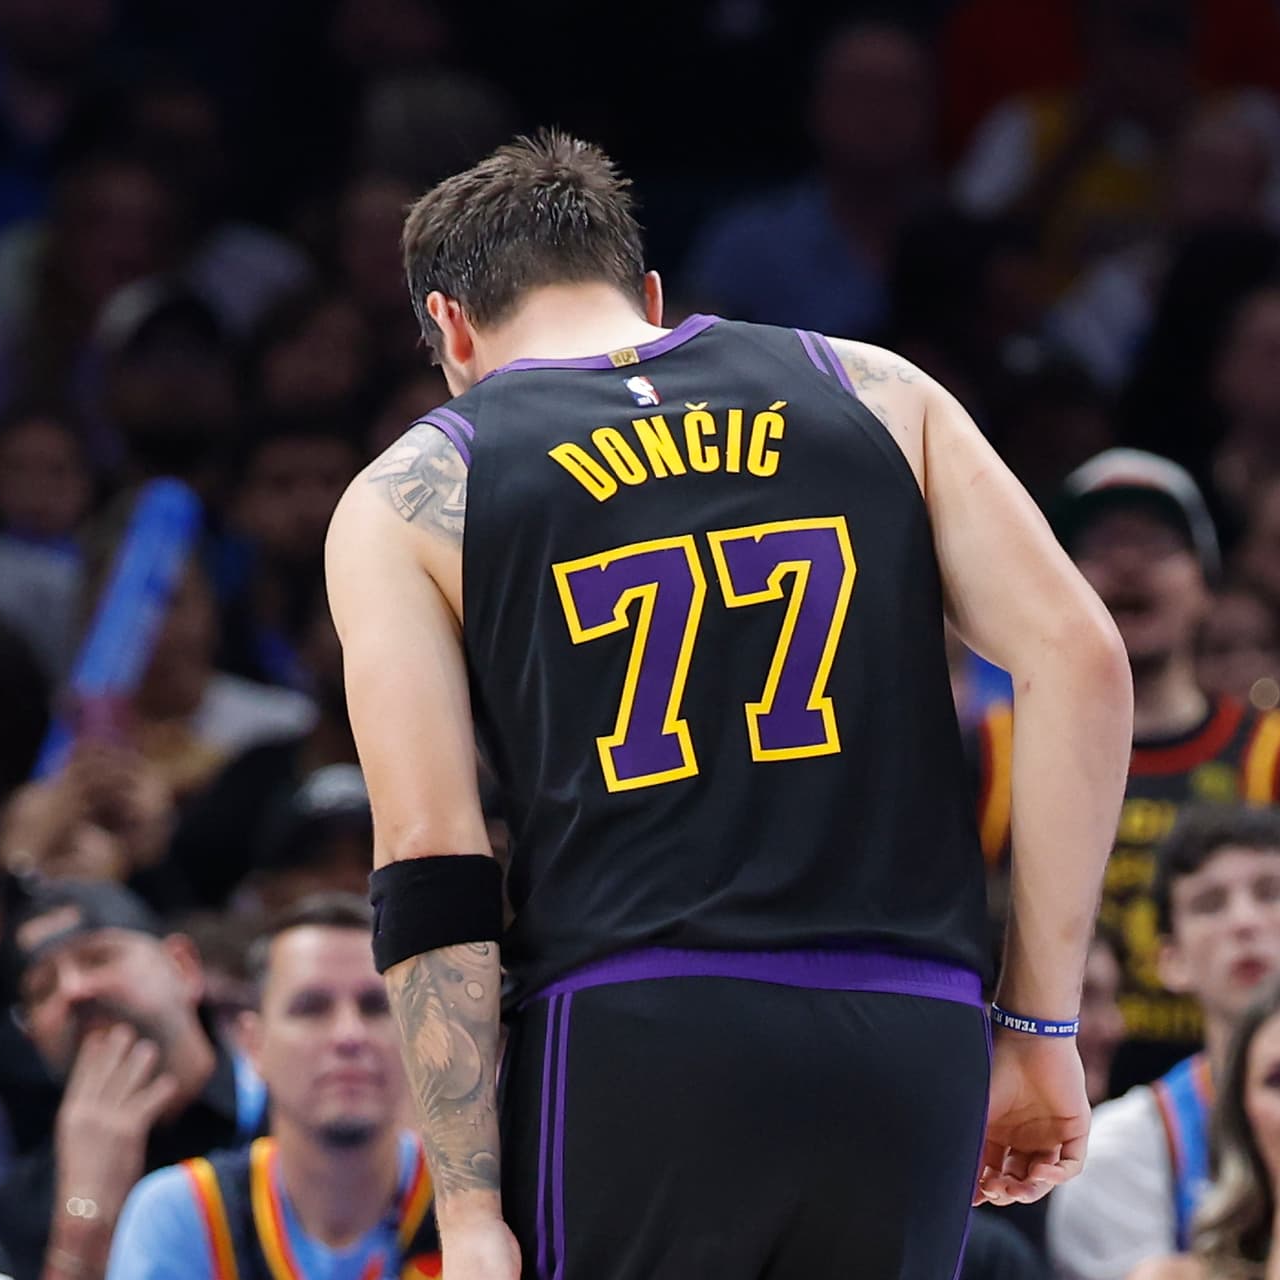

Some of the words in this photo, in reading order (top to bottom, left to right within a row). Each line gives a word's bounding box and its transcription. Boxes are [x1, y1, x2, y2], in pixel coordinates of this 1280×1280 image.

[548, 400, 787, 503] DONČIĆ
[552, 516, 857, 793] 77
[1005, 1015, 1037, 1034] TEAM
